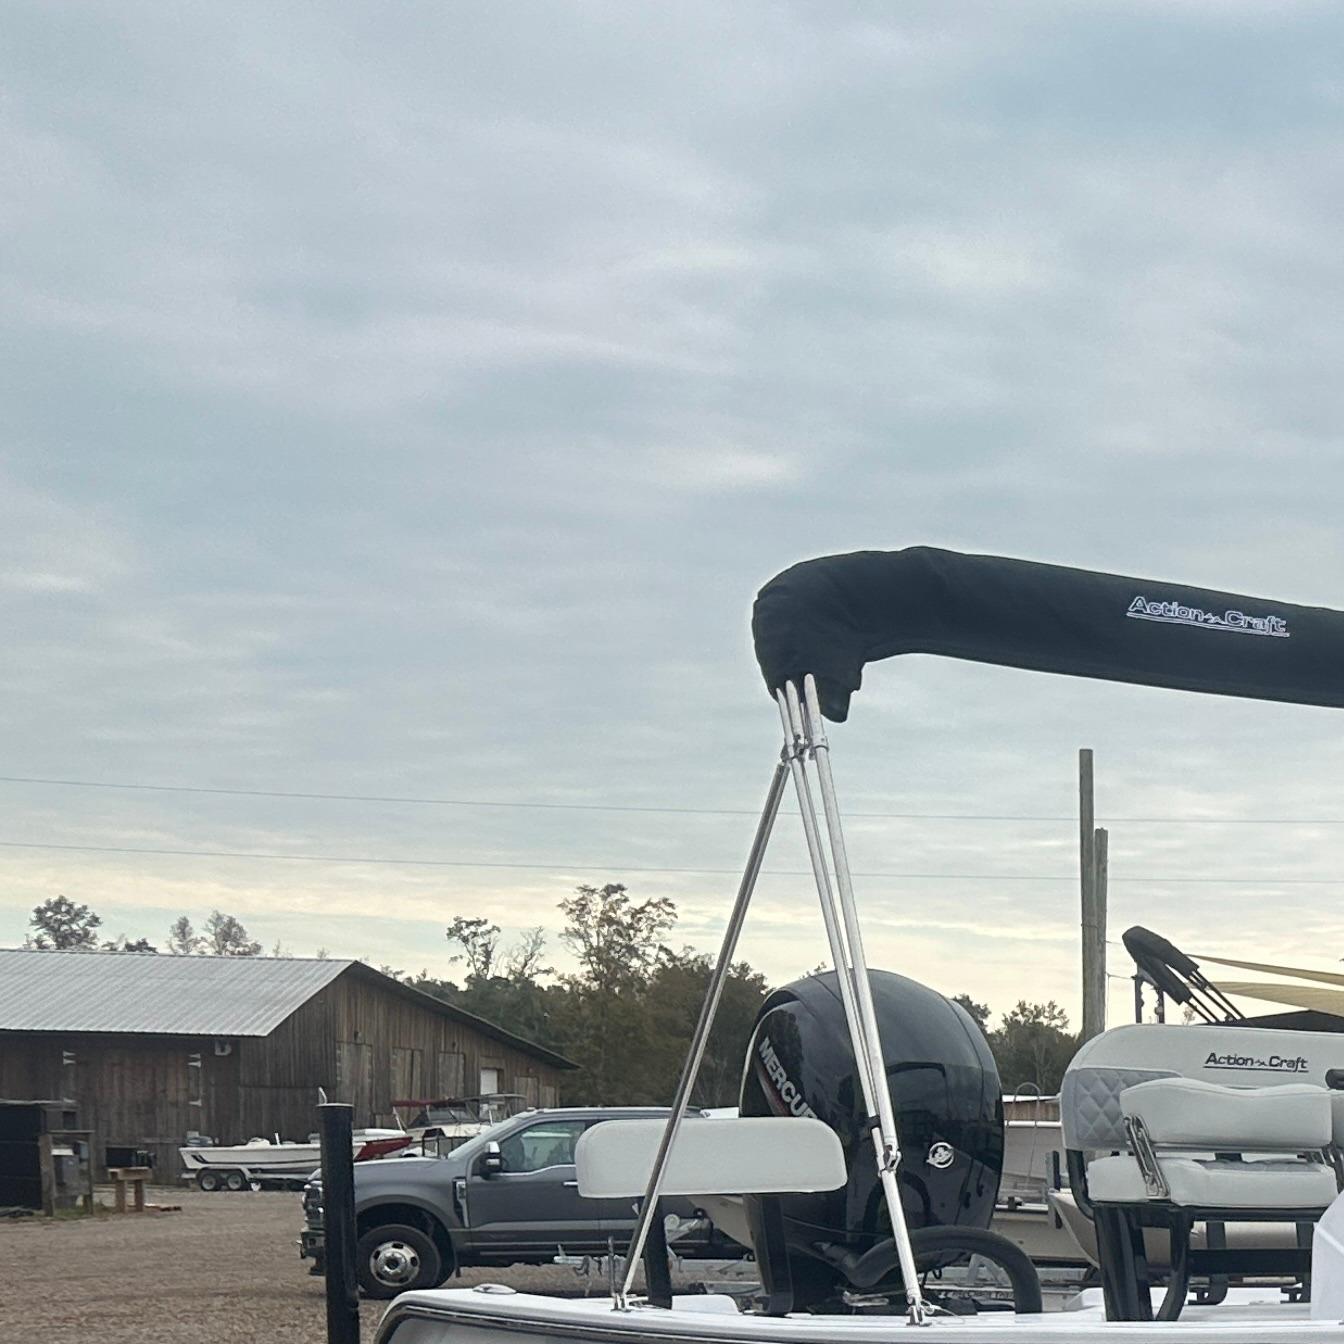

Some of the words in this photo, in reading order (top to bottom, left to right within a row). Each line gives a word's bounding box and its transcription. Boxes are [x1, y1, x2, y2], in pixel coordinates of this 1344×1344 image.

[1128, 596, 1204, 621] Action
[1224, 610, 1287, 634] Craft
[759, 1036, 818, 1118] MERCU
[1204, 1053, 1254, 1066] Action
[1268, 1056, 1308, 1072] Craft
